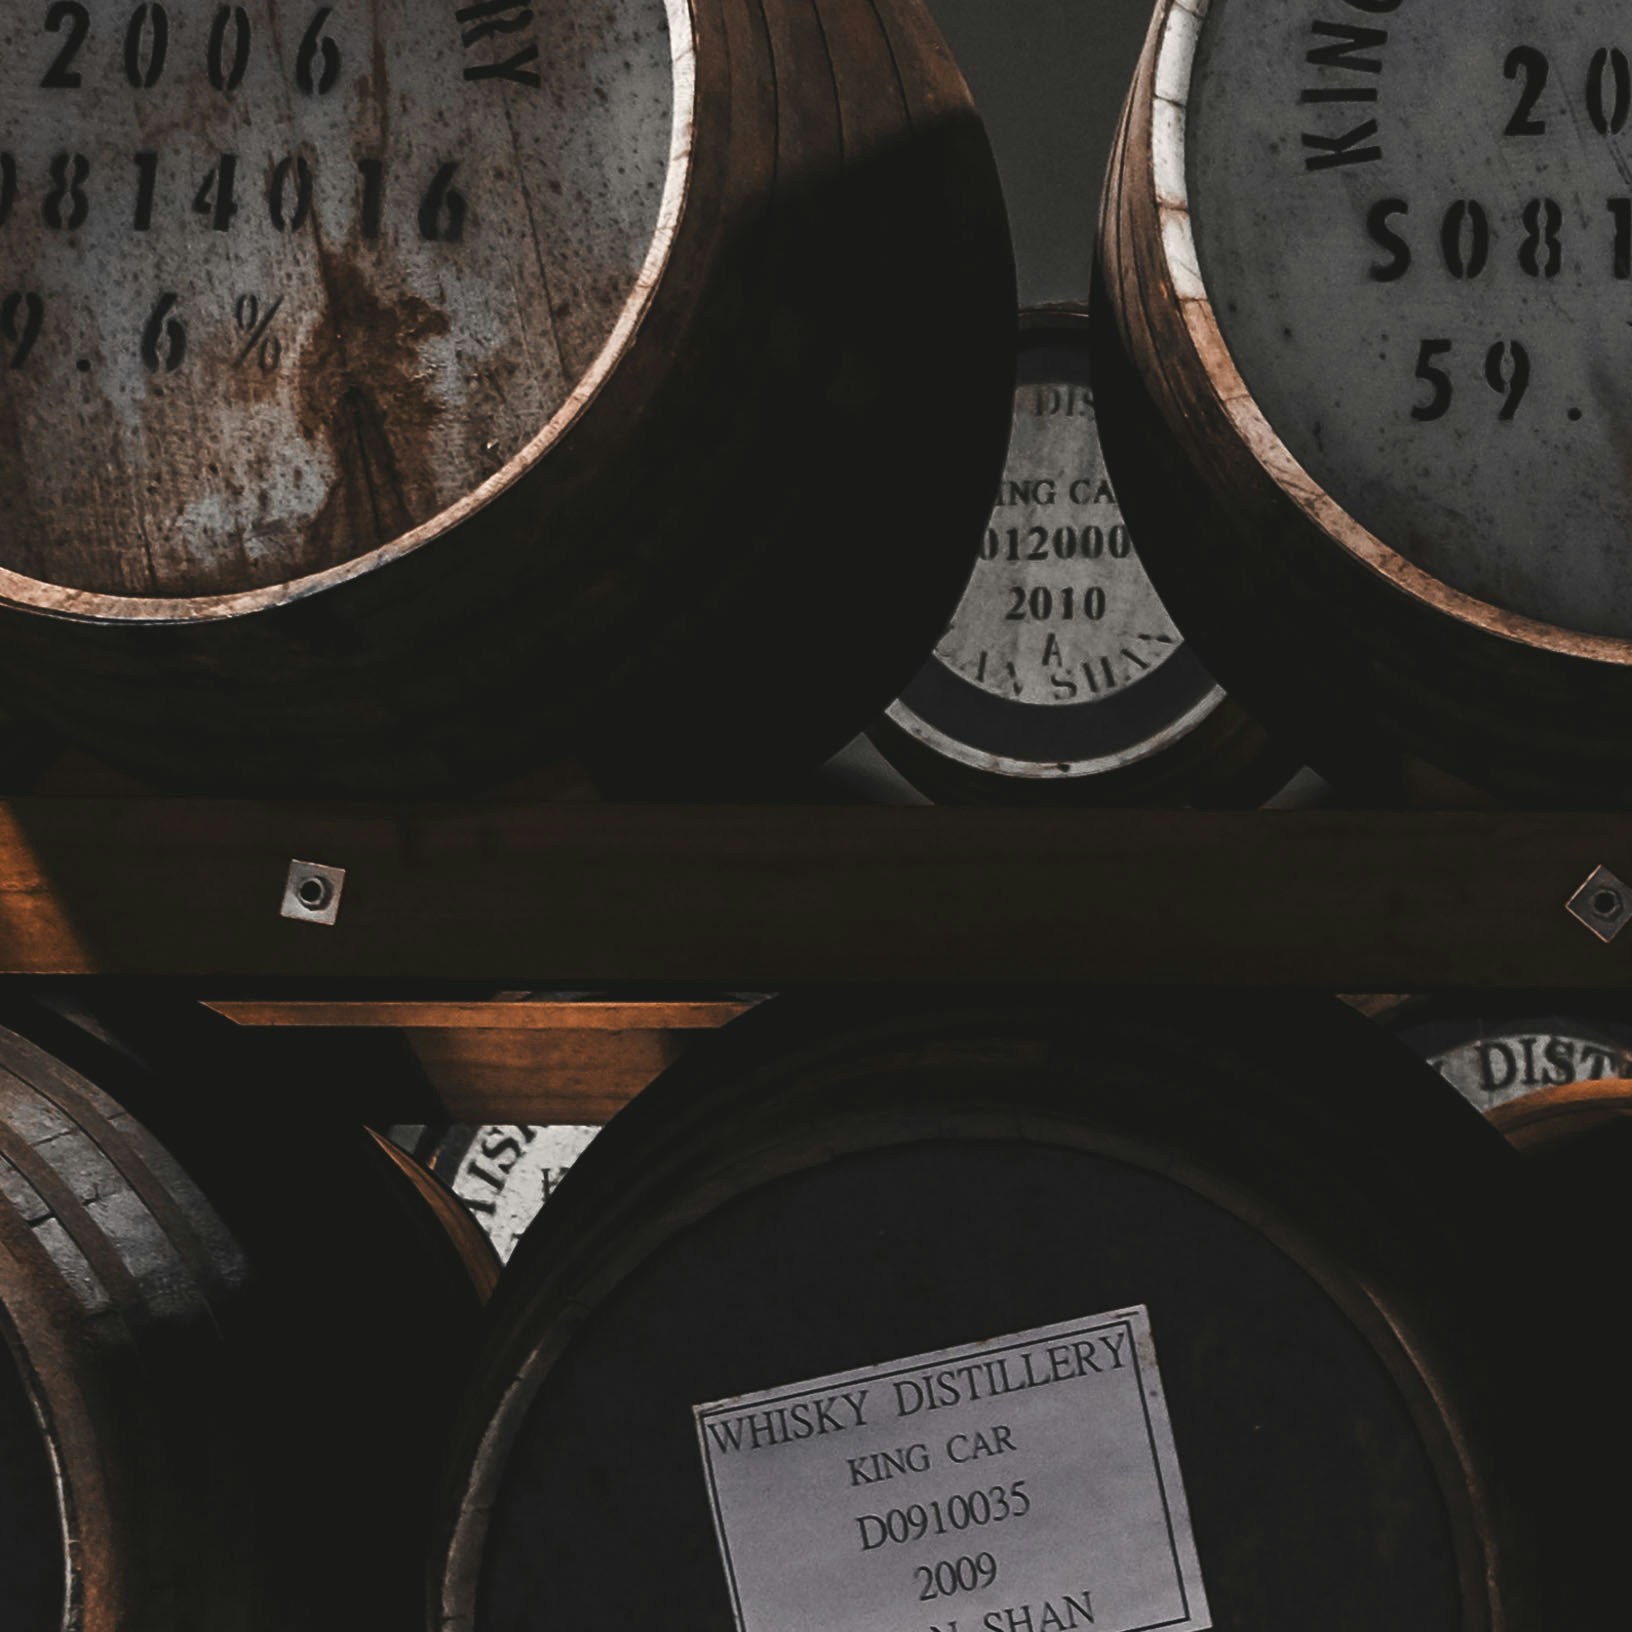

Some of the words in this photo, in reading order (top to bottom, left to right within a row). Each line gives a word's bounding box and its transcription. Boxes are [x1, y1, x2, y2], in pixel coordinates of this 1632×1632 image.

[40, 0, 342, 96] 2006
[1005, 585, 1107, 621] 2010
[1042, 633, 1063, 667] A
[708, 1389, 870, 1455] WHISKY
[894, 1332, 1128, 1418] DISTILLERY
[847, 1444, 932, 1487] KING
[945, 1425, 1017, 1464] CAR
[855, 1480, 1031, 1551] D0910035
[913, 1551, 999, 1602] 2009
